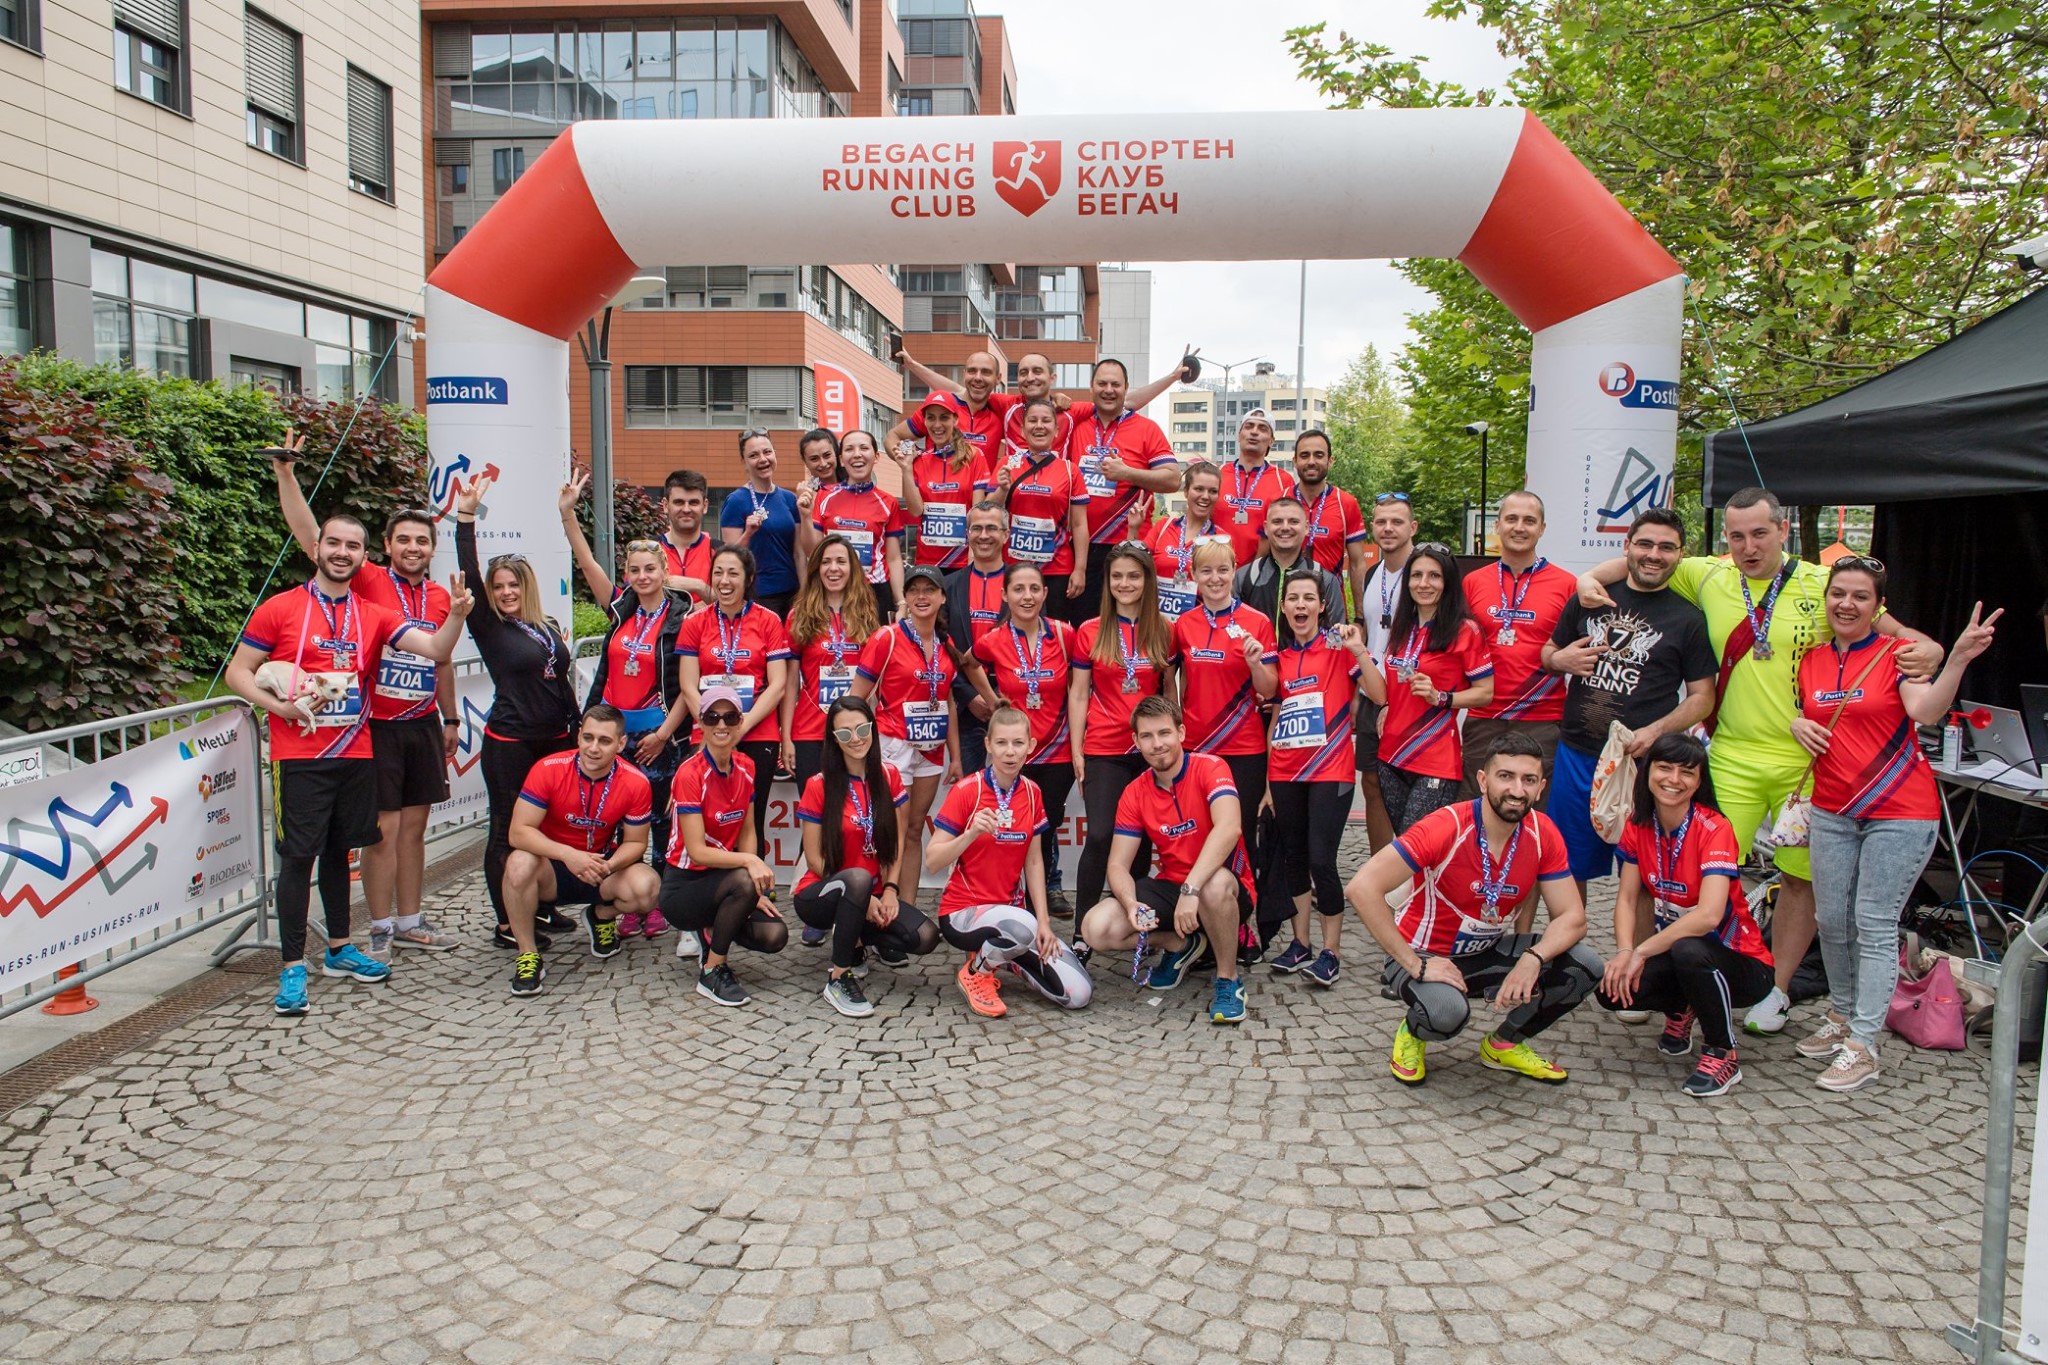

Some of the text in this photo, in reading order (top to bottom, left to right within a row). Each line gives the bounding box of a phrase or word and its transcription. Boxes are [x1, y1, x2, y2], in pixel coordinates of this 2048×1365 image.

[842, 143, 974, 164] BEGACH
[1078, 139, 1234, 161] СПОРТЕН
[823, 167, 975, 191] RUNNING
[1078, 164, 1164, 188] КЛУБ
[891, 195, 976, 218] CLUB
[1078, 192, 1178, 216] БЕГАЧ
[921, 521, 954, 536] 150B
[1010, 533, 1044, 552] 154D
[1612, 629, 1630, 649] 7
[380, 667, 423, 689] 170A
[1596, 660, 1641, 685] ING
[1581, 676, 1638, 696] KENNY
[906, 722, 939, 740] 154C
[1274, 716, 1310, 739] 170D
[198, 729, 238, 752] MetLife
[207, 808, 227, 823] SPORT
[206, 834, 242, 855] VIVACOM
[210, 859, 252, 886] BIODERMA
